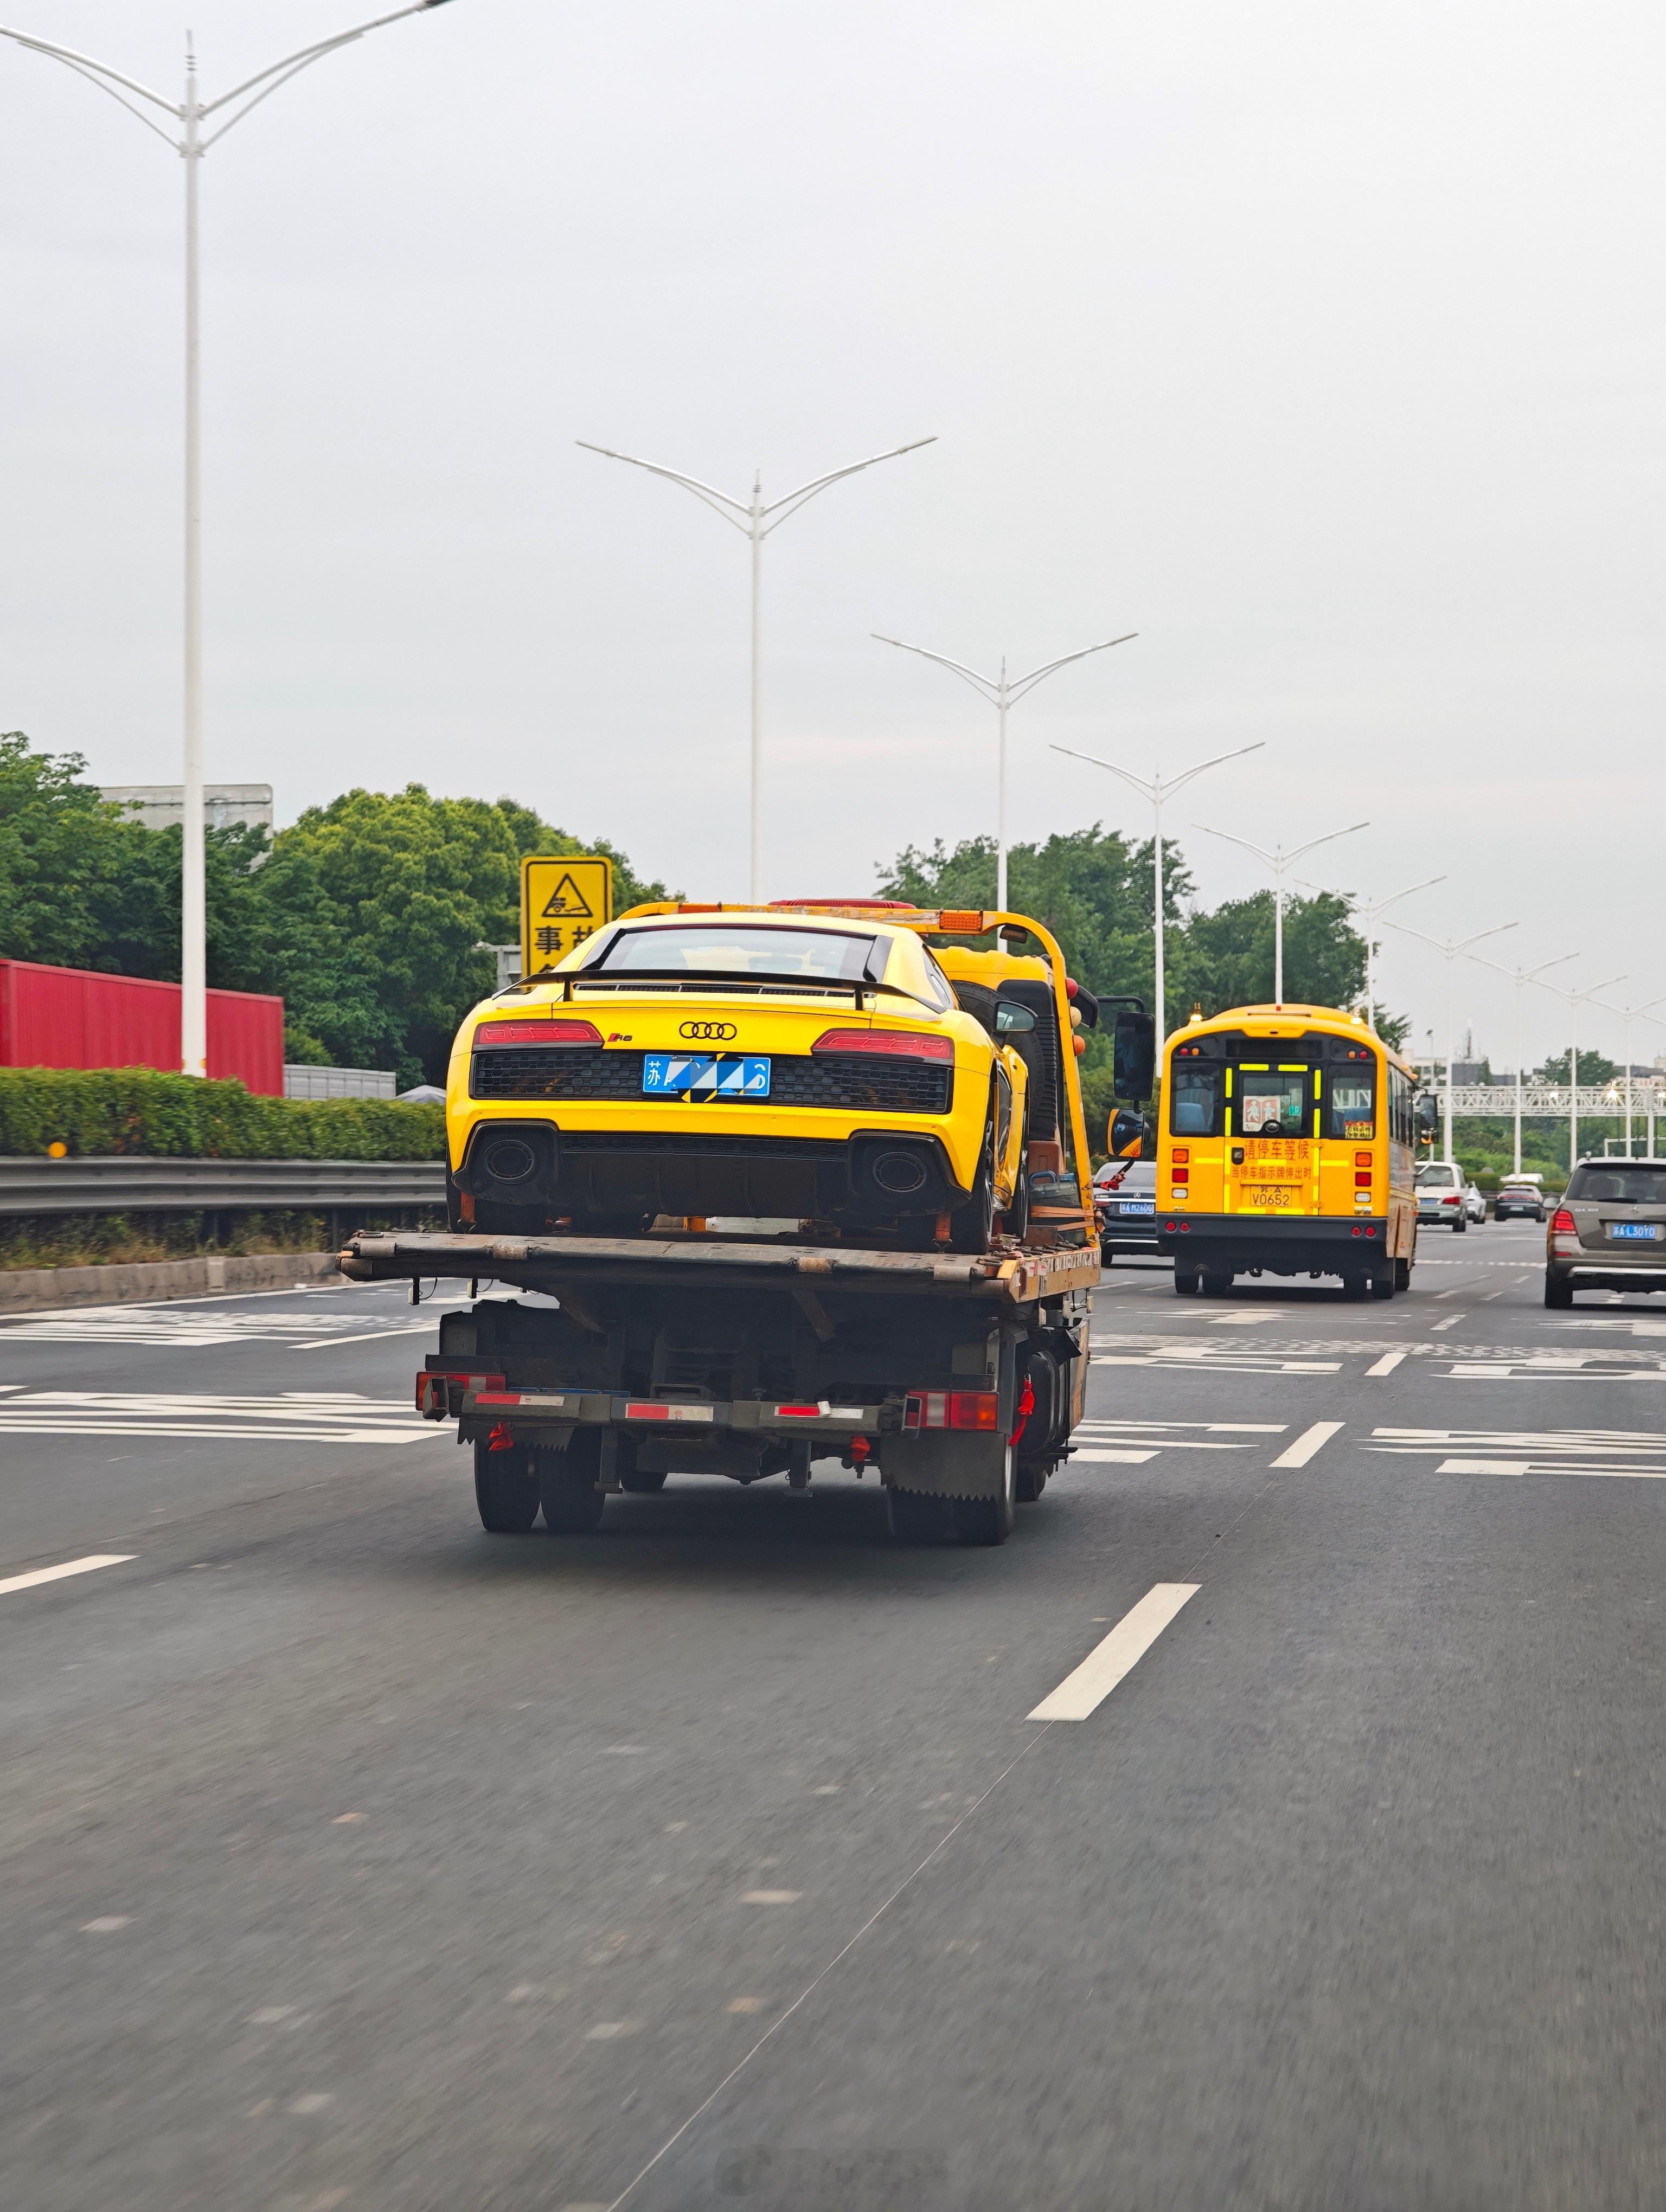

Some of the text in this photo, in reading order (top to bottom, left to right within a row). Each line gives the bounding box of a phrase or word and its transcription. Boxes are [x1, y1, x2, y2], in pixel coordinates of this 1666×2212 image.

[1245, 1139, 1309, 1160] 请停车等候
[1232, 1166, 1311, 1180] 当停车指示牌伸出时
[1252, 1193, 1290, 1206] V0652
